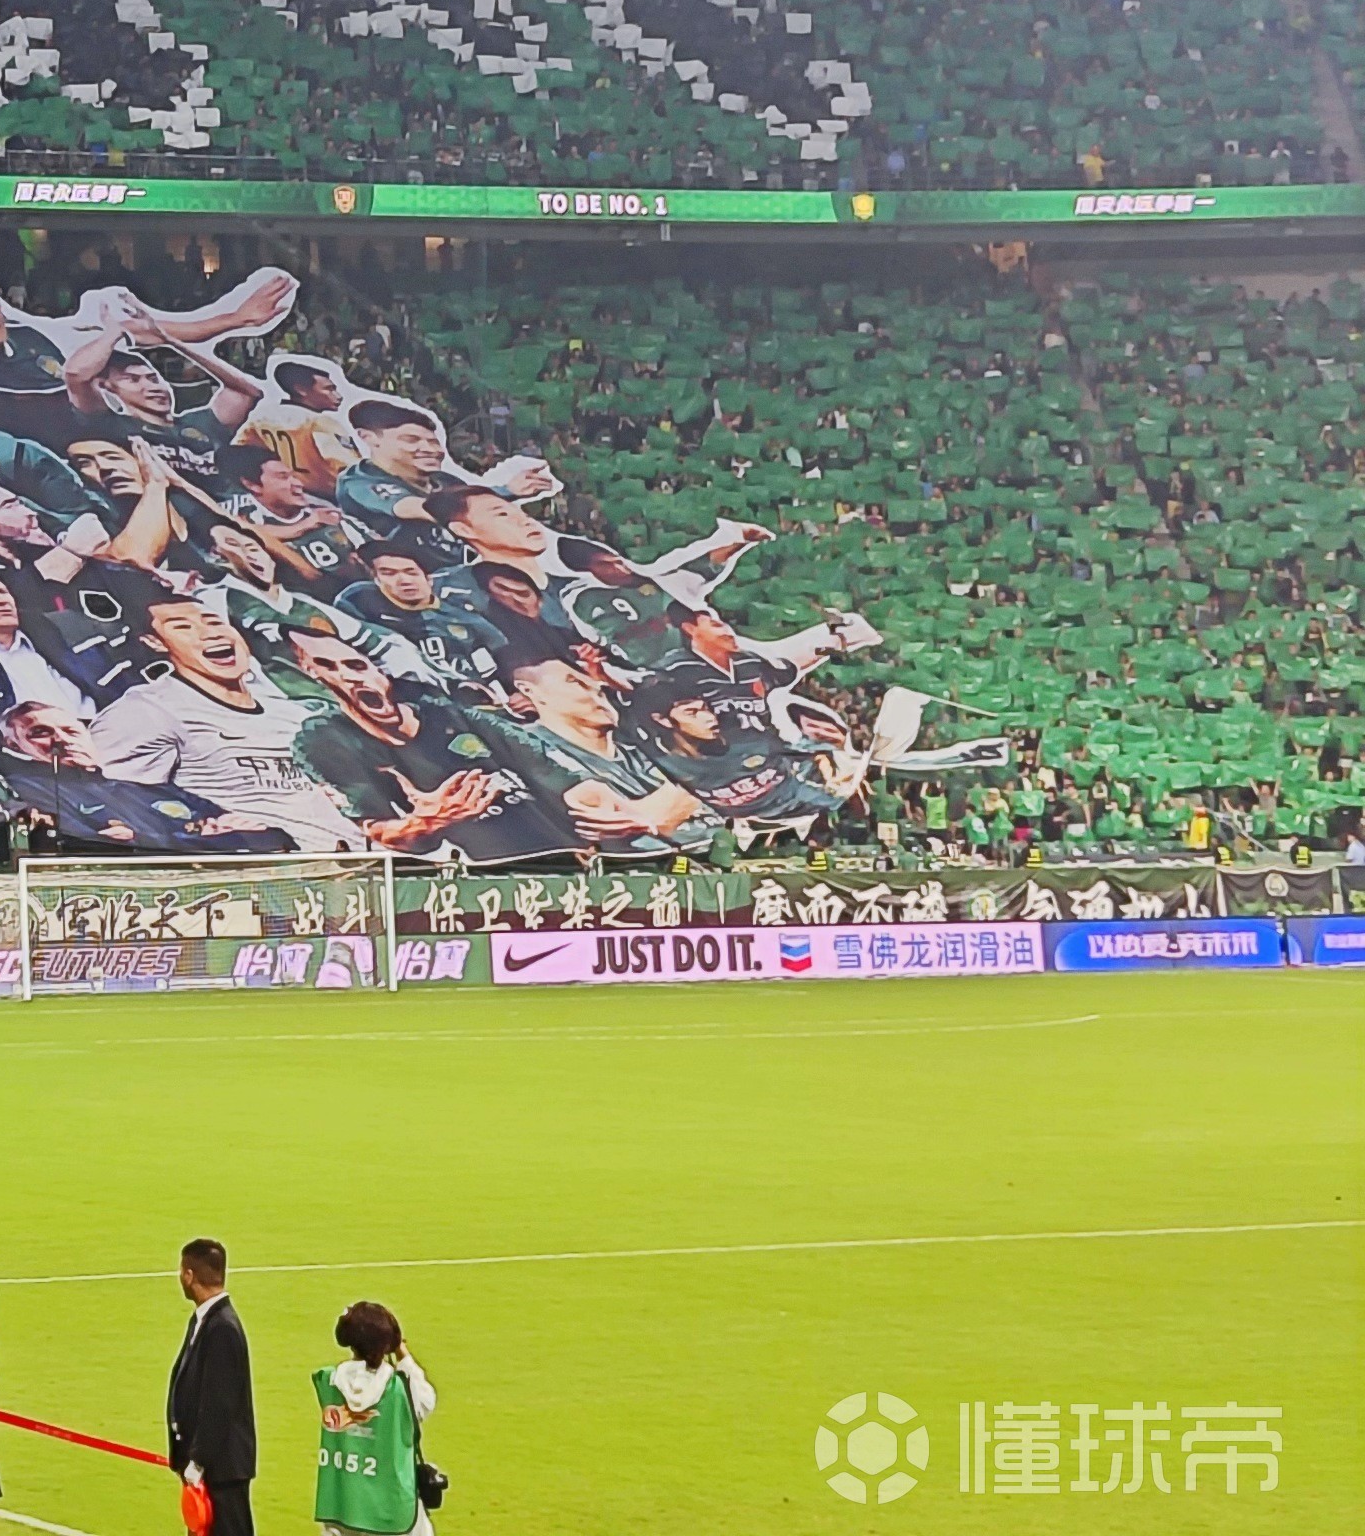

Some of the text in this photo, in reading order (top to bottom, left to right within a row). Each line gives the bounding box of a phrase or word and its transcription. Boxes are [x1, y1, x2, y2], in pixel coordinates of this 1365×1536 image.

[538, 193, 668, 216] TO BE NO. 1
[300, 540, 339, 569] 18
[711, 698, 767, 715] RYOB
[592, 933, 762, 975] JUST DO IT.
[833, 930, 1034, 970] 雪佛龙润滑油
